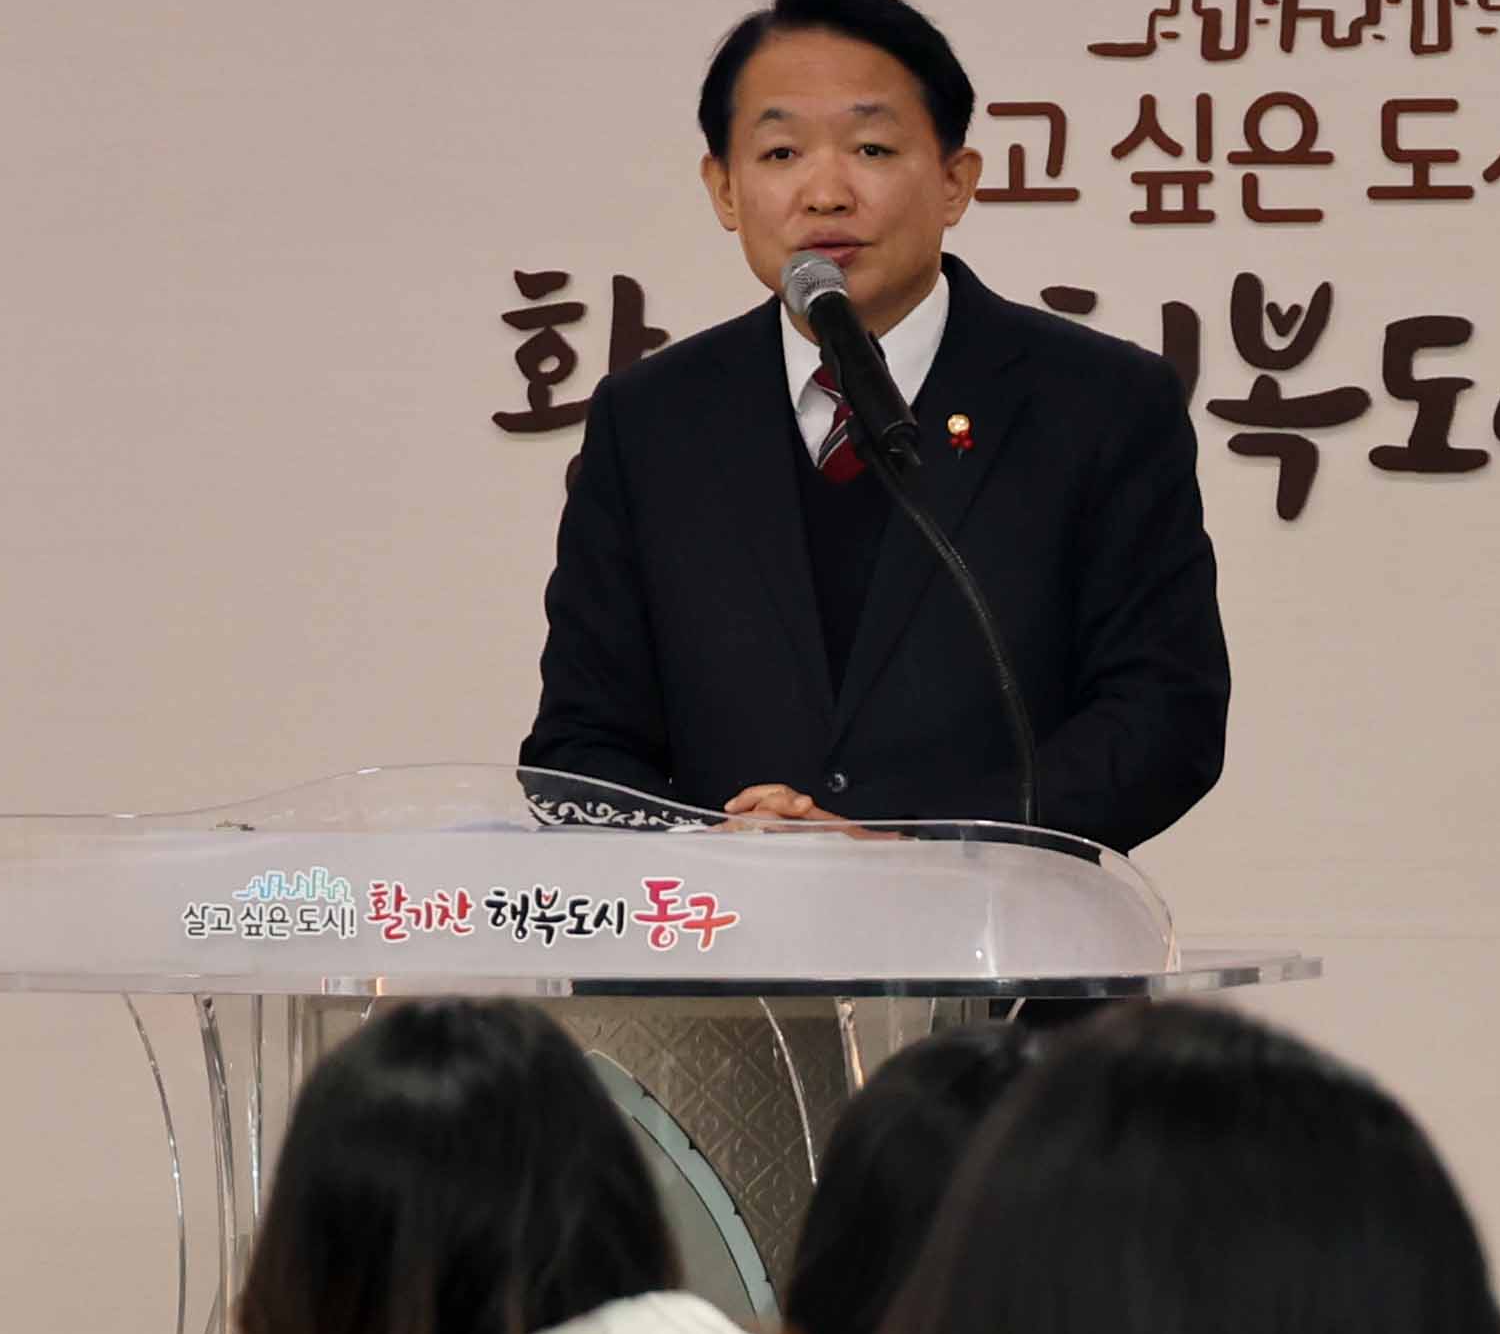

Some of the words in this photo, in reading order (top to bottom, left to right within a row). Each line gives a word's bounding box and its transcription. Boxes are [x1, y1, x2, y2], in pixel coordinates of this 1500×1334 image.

[975, 101, 1081, 204] 고
[1110, 90, 1335, 225] 싶은
[182, 903, 233, 937] 살고
[239, 905, 290, 938] 싶은
[296, 905, 356, 937] 도시!
[366, 882, 474, 940] 활기찬
[485, 885, 626, 946] 행복도시
[634, 877, 738, 949] 동구
